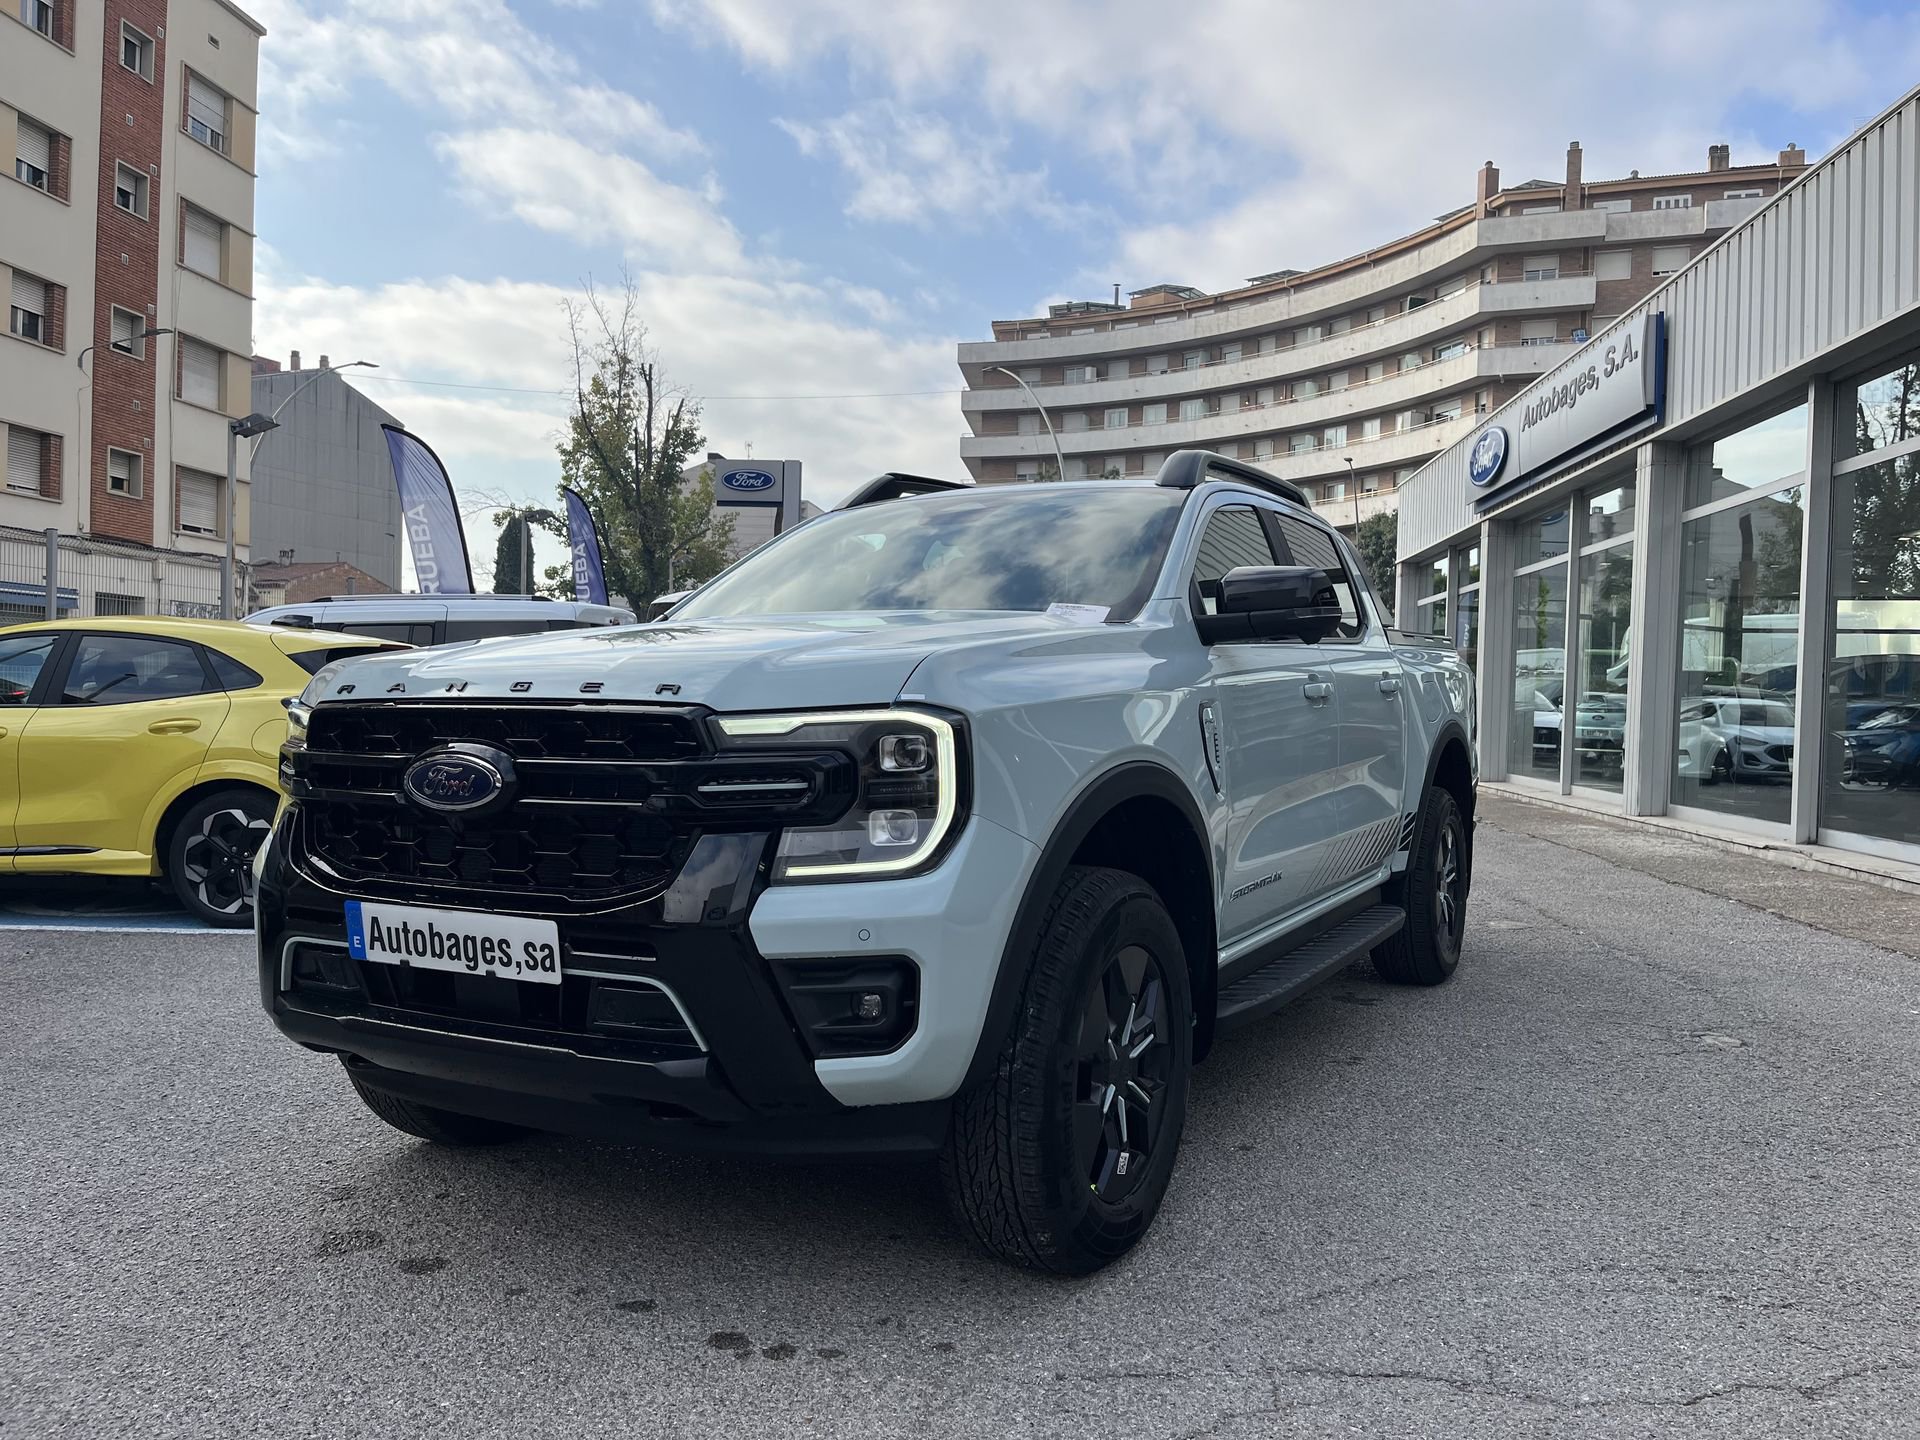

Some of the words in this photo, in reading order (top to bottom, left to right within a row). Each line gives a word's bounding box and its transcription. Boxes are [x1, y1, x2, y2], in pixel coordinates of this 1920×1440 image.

[1521, 364, 1600, 432] Autobages,
[1603, 333, 1639, 378] S.A.
[1473, 437, 1497, 477] Ford
[732, 472, 764, 487] Ford
[574, 542, 591, 603] UEBA
[336, 680, 682, 696] RANGER
[423, 764, 475, 797] Ford
[353, 935, 362, 948] E
[369, 916, 556, 975] Autobages,sa
